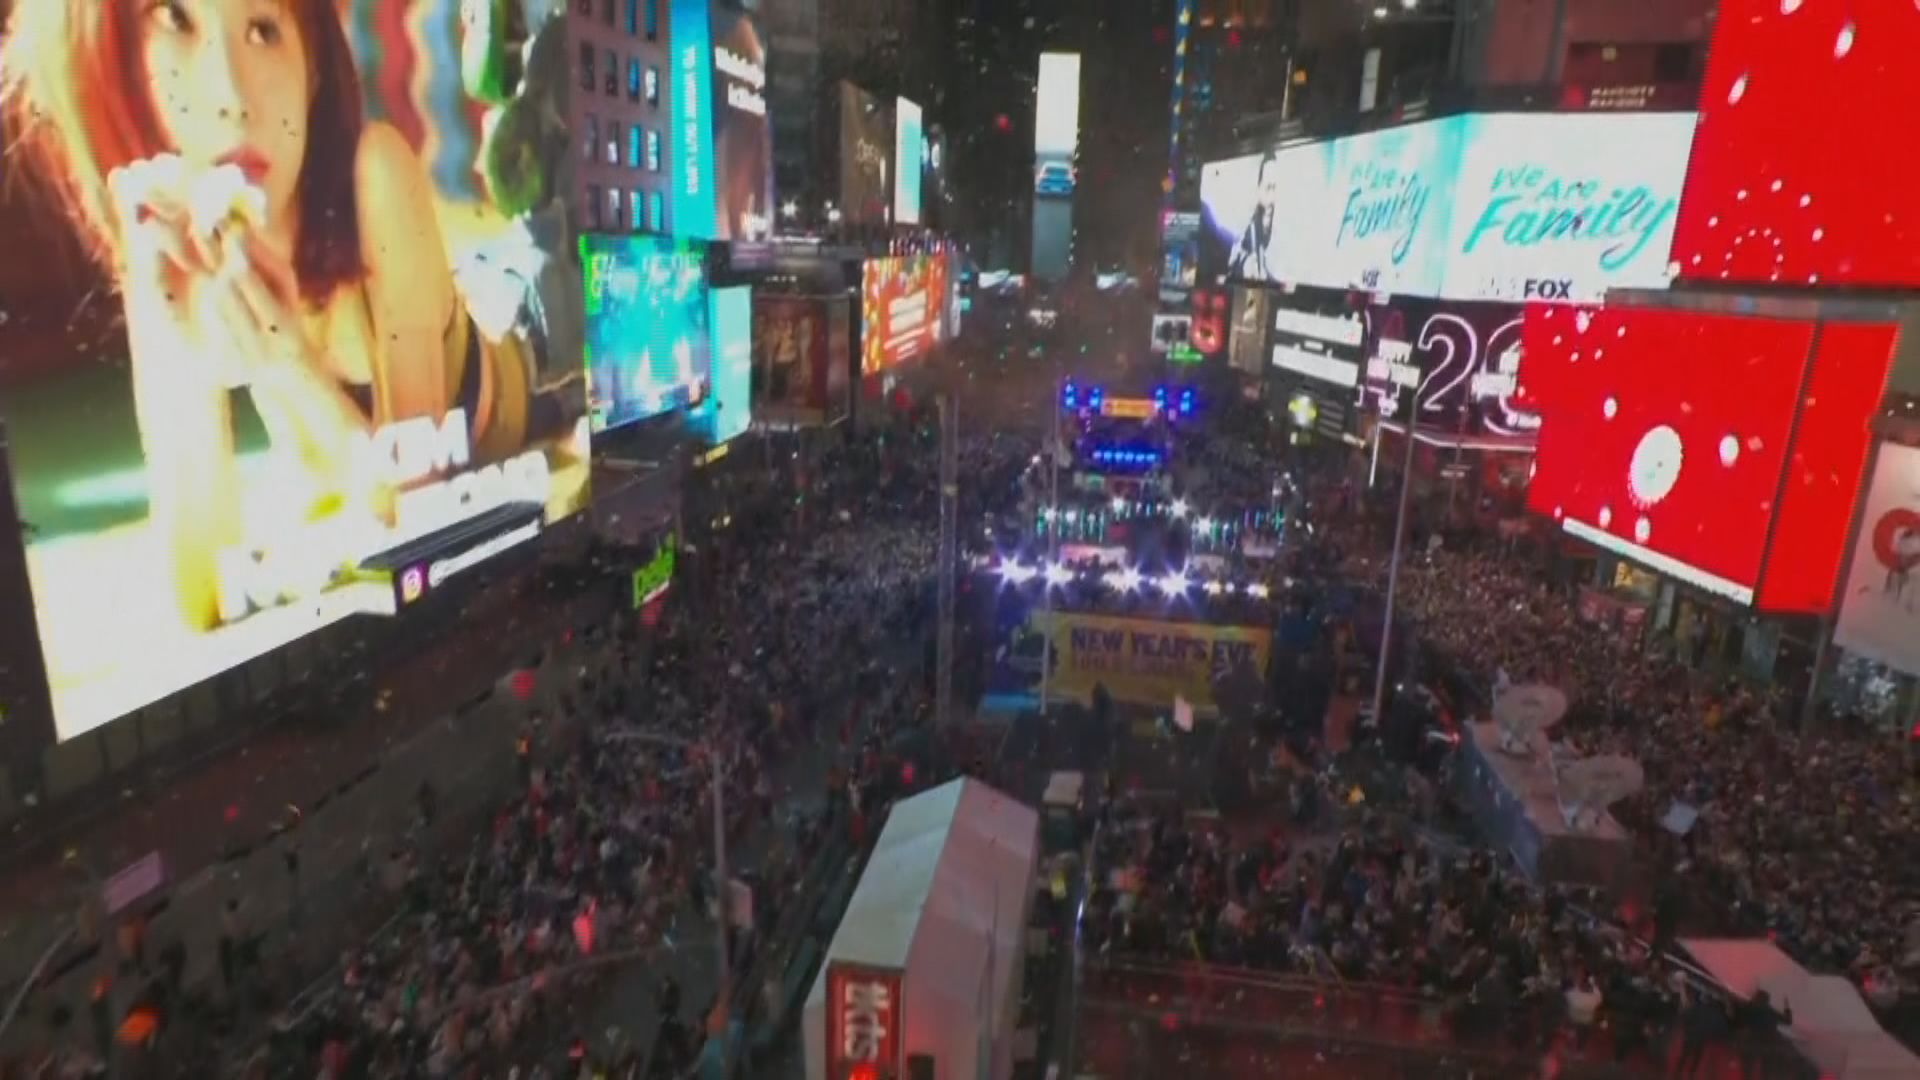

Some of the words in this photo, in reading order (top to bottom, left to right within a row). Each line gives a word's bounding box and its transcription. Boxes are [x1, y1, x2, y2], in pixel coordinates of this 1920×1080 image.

[1538, 179, 1598, 203] Are
[1336, 171, 1431, 266] Family
[1462, 187, 1676, 272] Family
[1523, 278, 1574, 300] FOX
[1071, 626, 1124, 653] NEW
[1130, 631, 1208, 660] YEAR'S
